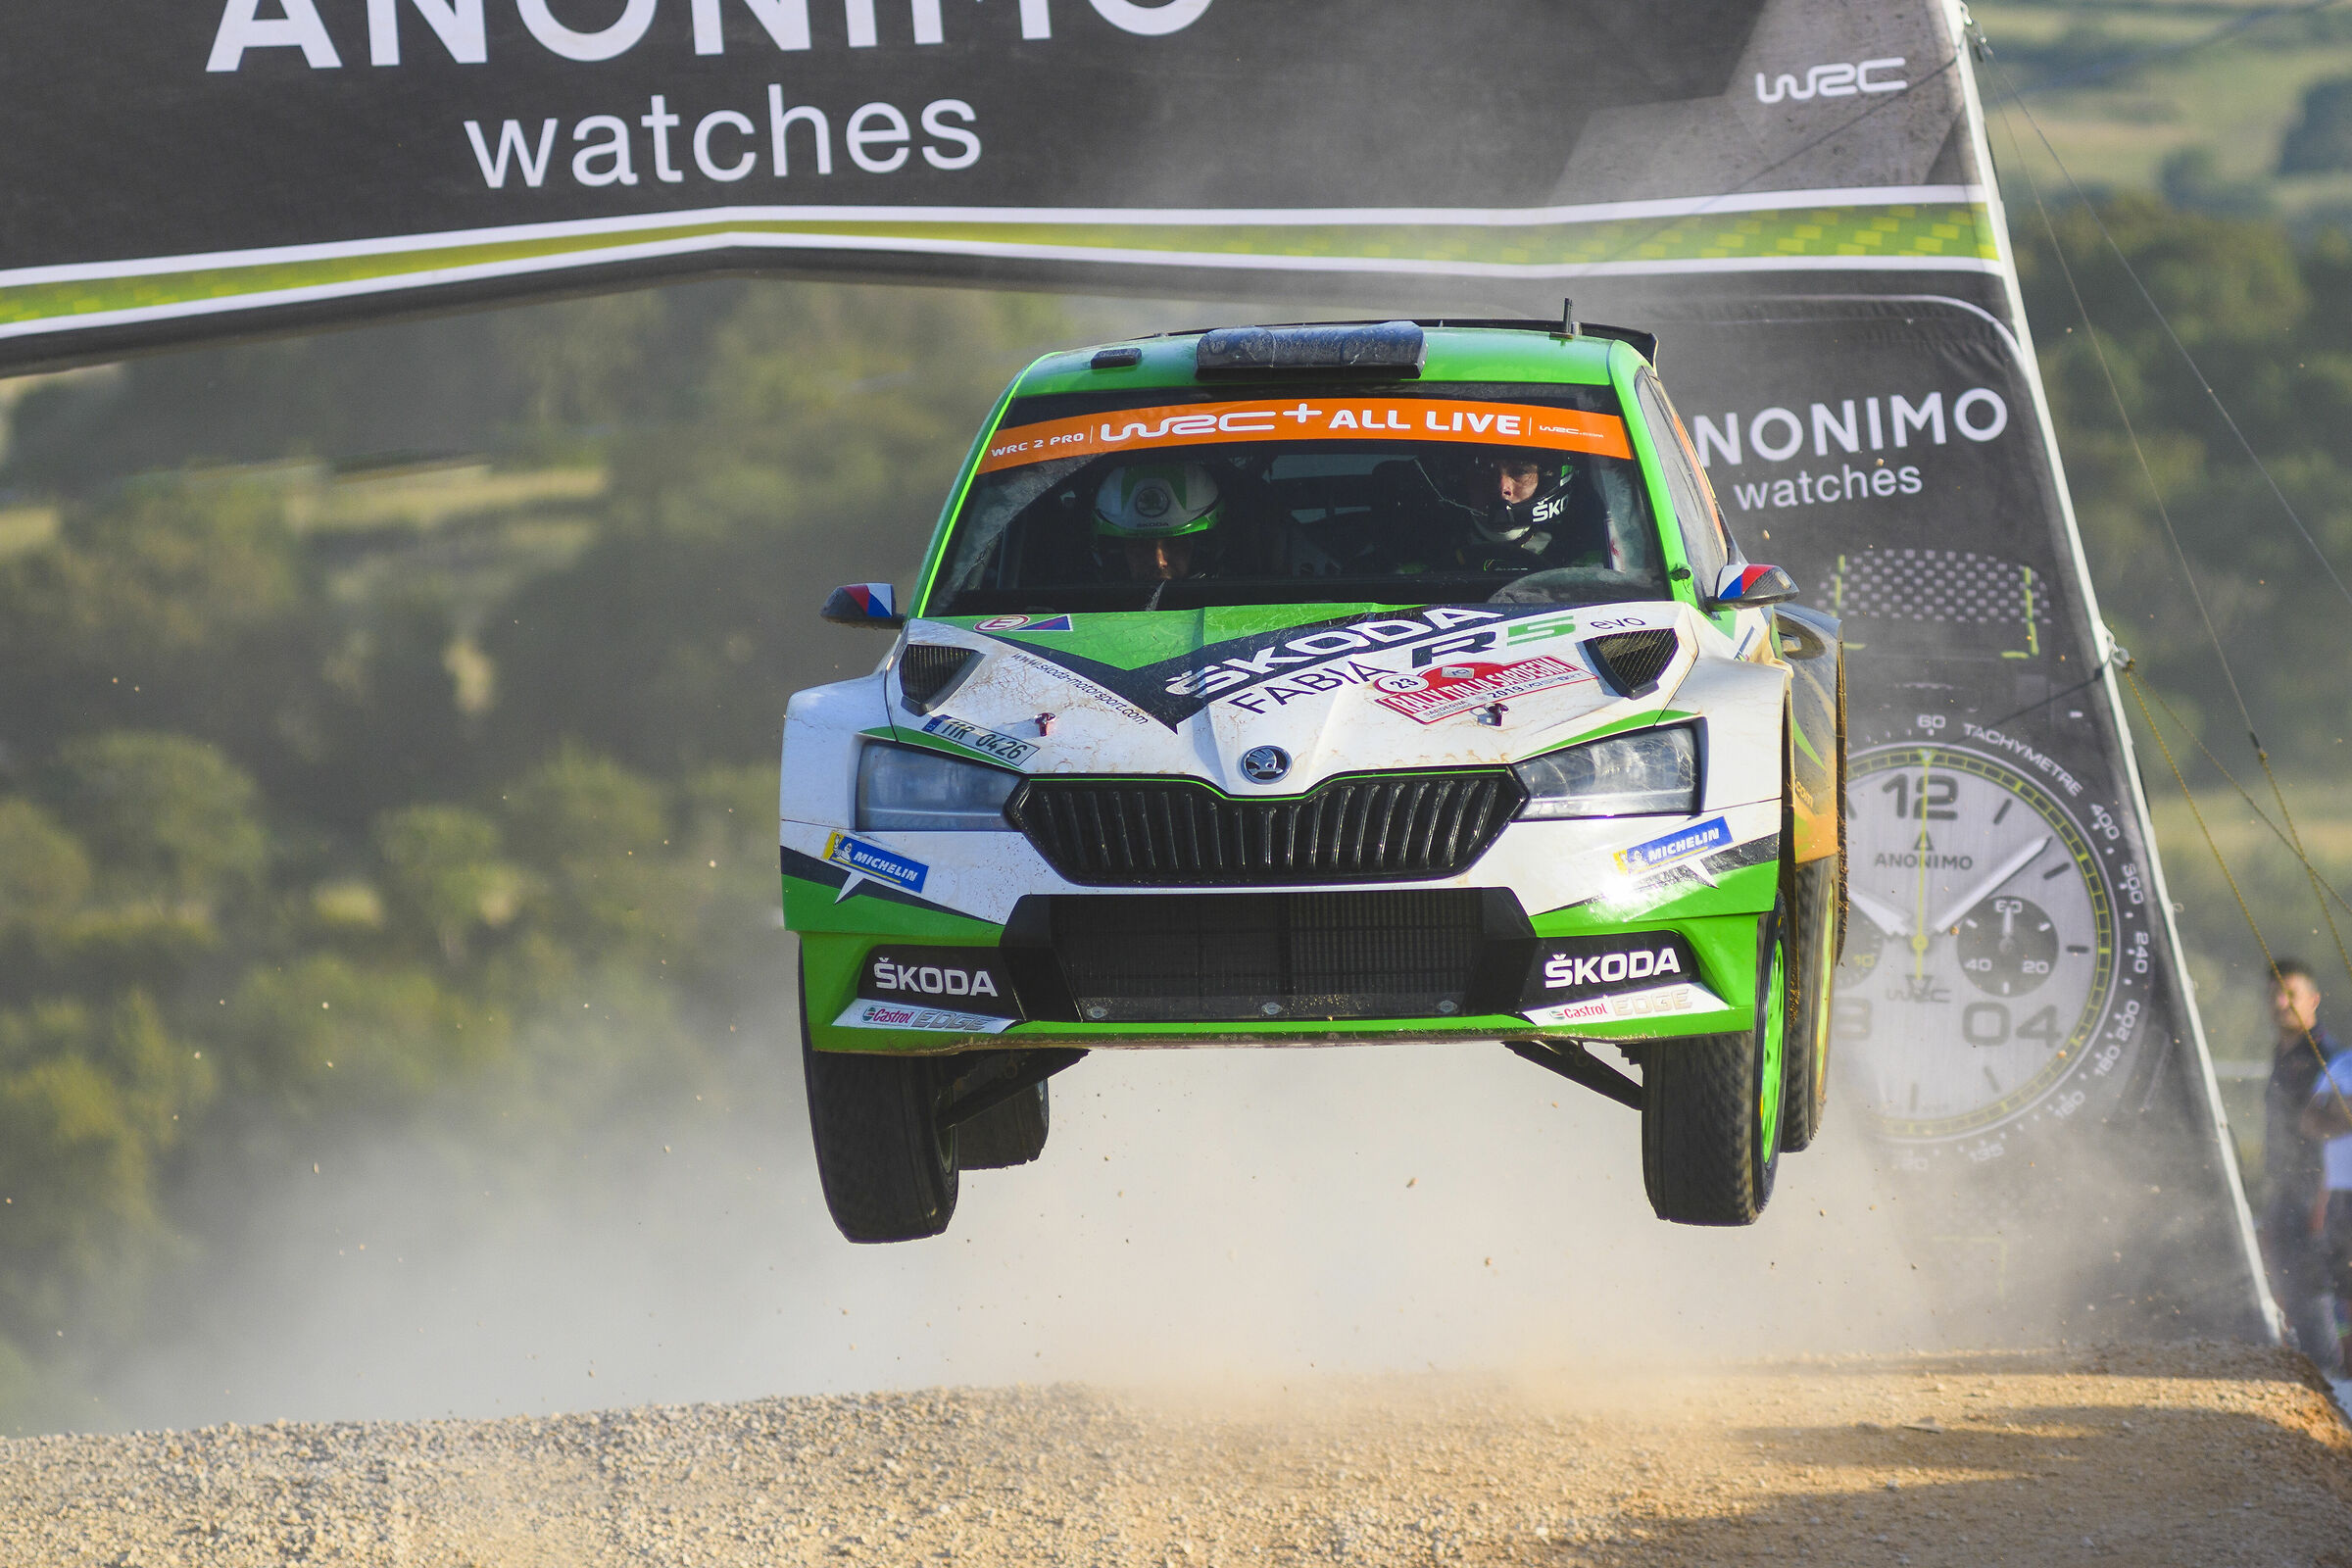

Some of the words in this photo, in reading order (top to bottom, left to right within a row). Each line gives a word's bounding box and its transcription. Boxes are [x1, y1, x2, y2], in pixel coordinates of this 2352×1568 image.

[1756, 57, 1907, 103] WRC
[464, 83, 981, 189] watches
[1328, 410, 1411, 429] ALL
[1426, 411, 1521, 435] LIVE
[1693, 387, 2009, 467] NONIMO
[991, 442, 1028, 458] WRC
[1032, 439, 1044, 449] 2
[1050, 432, 1084, 446] PRO
[1733, 464, 1924, 511] watches
[985, 617, 1020, 628] E
[1590, 616, 1647, 630] evo
[1164, 607, 1505, 699] ŠKODA
[1227, 661, 1399, 714] FABIA
[1388, 689, 1452, 714] RALLY
[1437, 676, 1499, 700] ITALIA
[1486, 655, 1575, 687] SARDEGNA
[1390, 678, 1418, 689] 23
[1488, 686, 1525, 699] 2019
[1917, 715, 1946, 729] 60
[975, 732, 1028, 760] 0426
[1963, 723, 2083, 798] TACHYMETRE
[1882, 772, 1959, 820] 12
[2089, 803, 2121, 840] 400
[1648, 827, 1721, 862] MICHELIN
[1874, 853, 1974, 870] ANONIMO
[853, 851, 918, 883] MICHELIN
[2121, 862, 2144, 905] 300
[1544, 948, 1682, 990] ŠKODA
[1965, 958, 1992, 972] 40
[2022, 960, 2049, 974] 20
[2133, 931, 2149, 973] 240
[873, 956, 1000, 998] ŠKODA
[873, 1008, 915, 1024] Castrol
[914, 1009, 997, 1031] EDGE
[1564, 1003, 1608, 1020] Castrol
[1612, 988, 1694, 1017] EDGE
[2116, 1000, 2140, 1042] 200
[1963, 1002, 2062, 1049] 04
